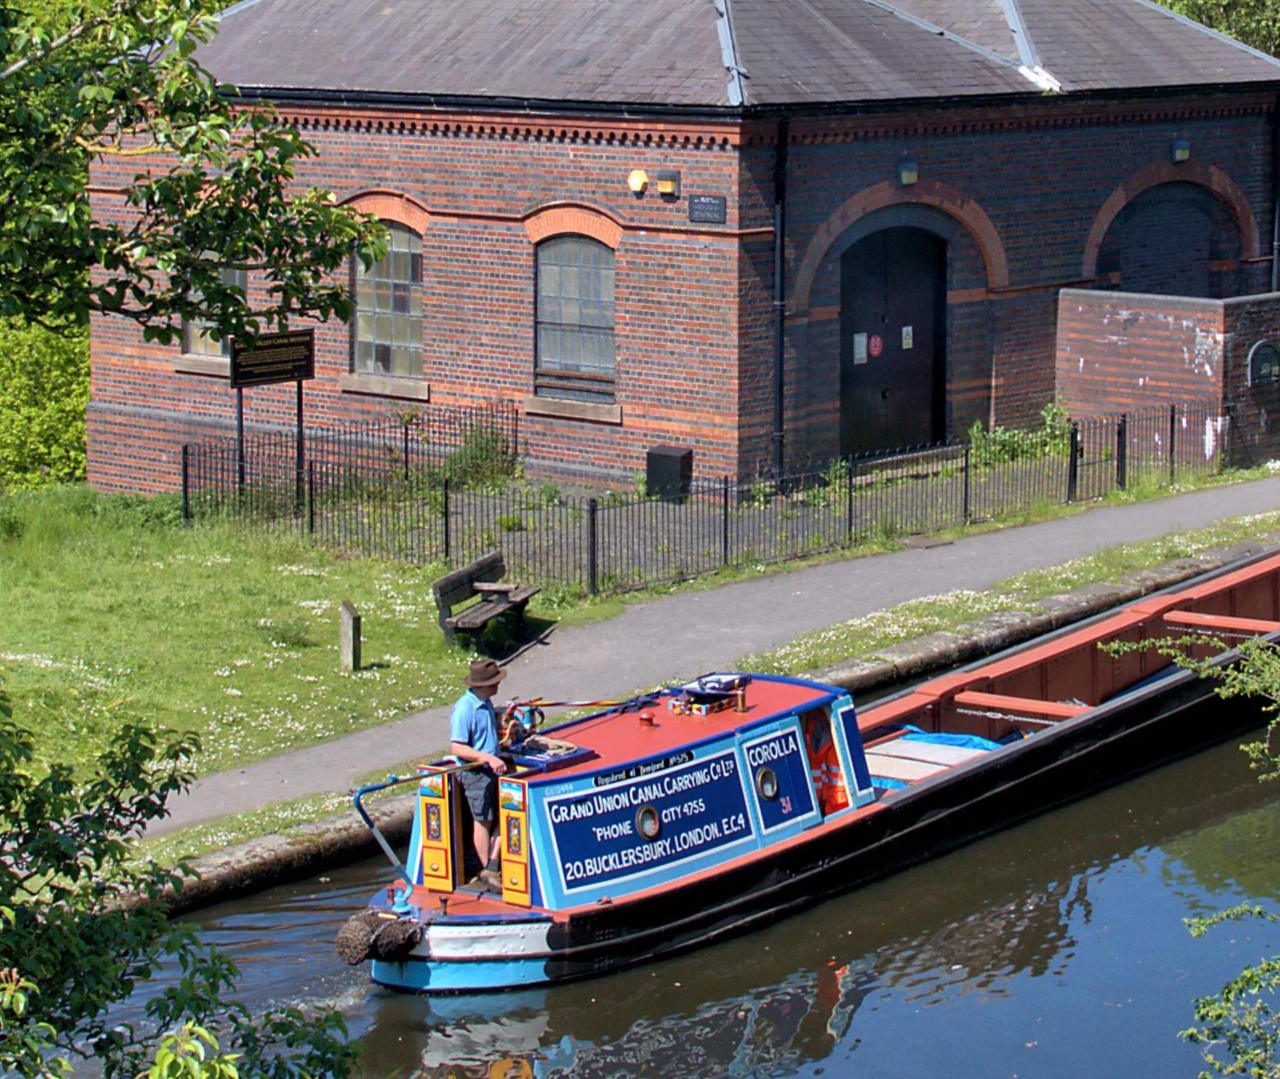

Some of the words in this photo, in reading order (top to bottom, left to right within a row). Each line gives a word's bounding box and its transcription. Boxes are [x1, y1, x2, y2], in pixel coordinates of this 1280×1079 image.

[749, 736, 797, 767] COROLLA
[551, 801, 594, 823] GRAND
[593, 791, 630, 814] UNION
[629, 783, 665, 805] CANAL
[664, 768, 710, 795] CARRYING
[661, 805, 681, 823] CITY
[682, 798, 705, 816] 4755
